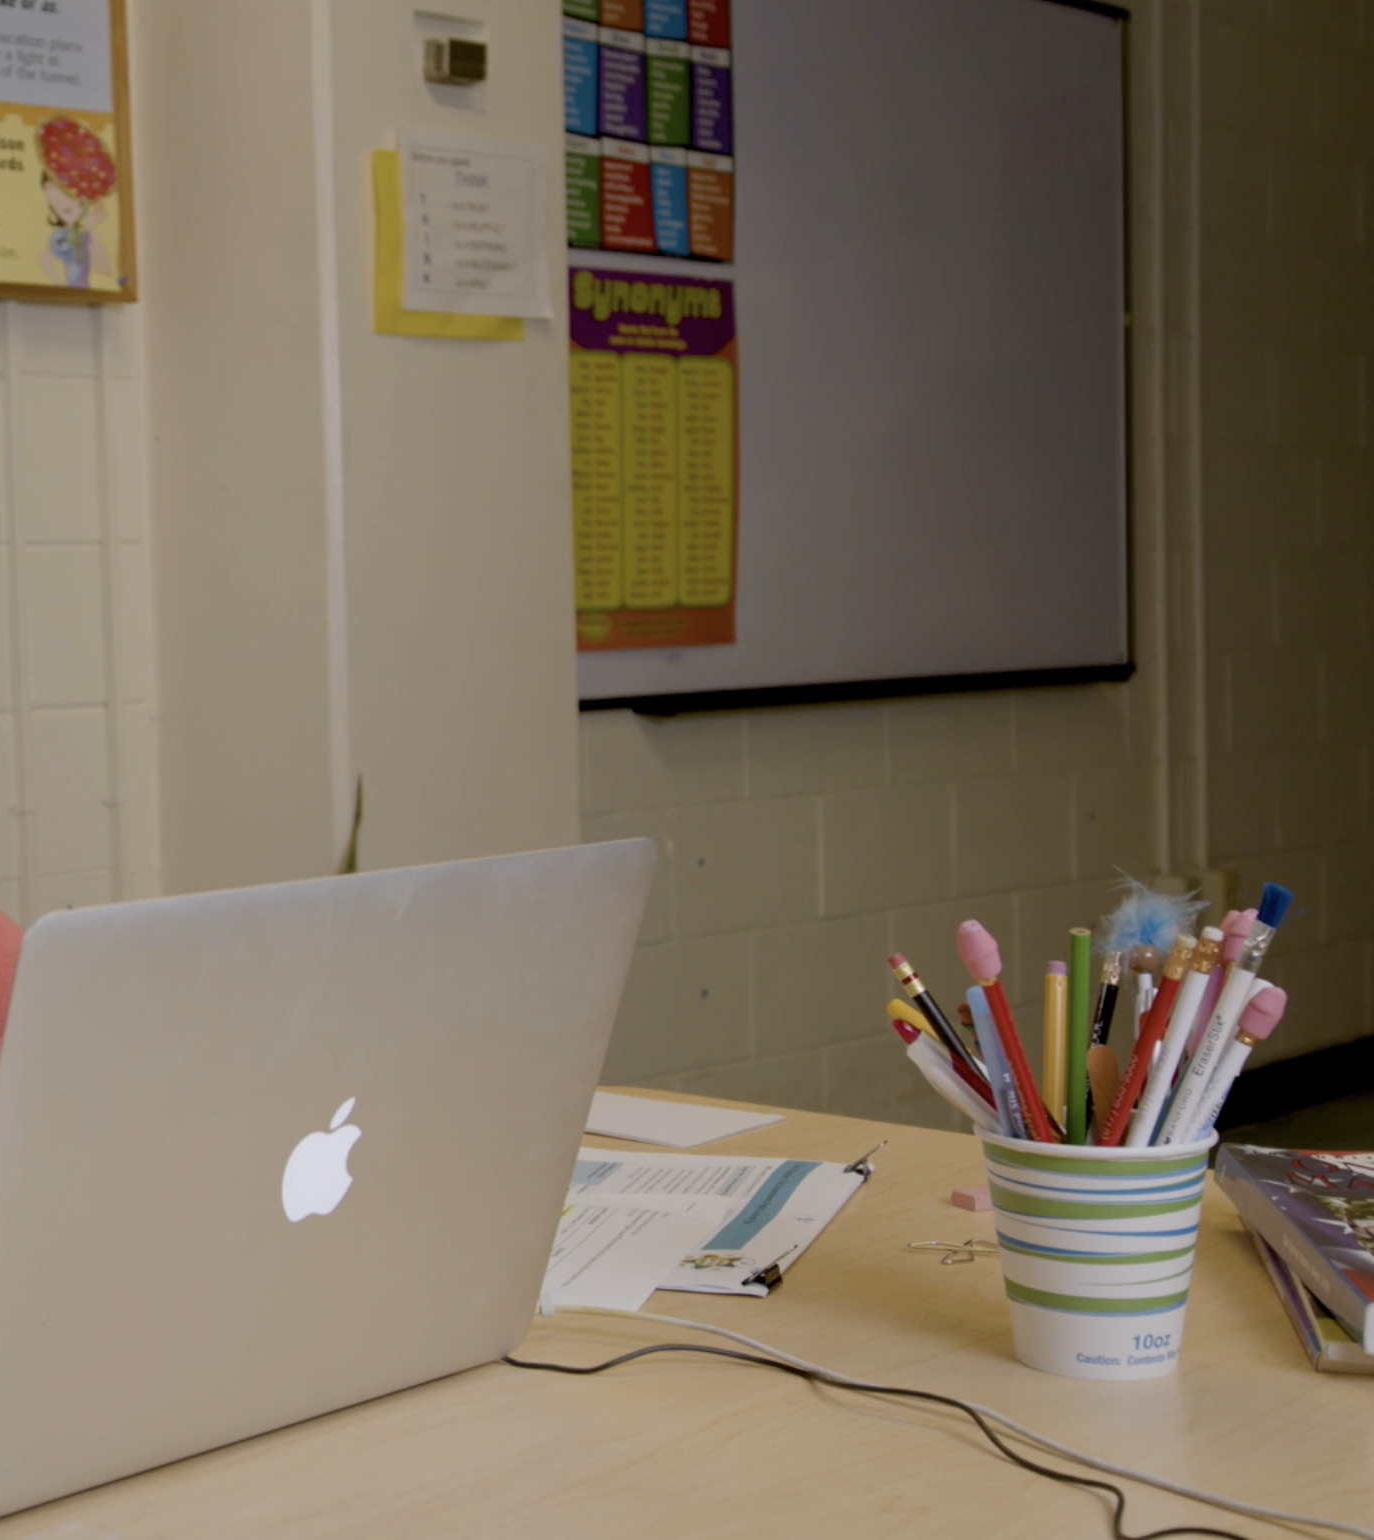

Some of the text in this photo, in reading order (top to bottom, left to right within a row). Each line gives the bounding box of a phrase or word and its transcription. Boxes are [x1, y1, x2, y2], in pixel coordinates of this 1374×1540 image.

[49, 36, 83, 53] plans
[4, 50, 13, 61] a
[17, 49, 44, 66] light
[47, 54, 60, 66] at
[0, 64, 13, 78] of
[16, 66, 36, 81] the
[573, 270, 722, 325] Synonyms
[1132, 1333, 1171, 1350] 10oz
[1076, 1352, 1122, 1366] Caution:
[1127, 1354, 1165, 1366] Contents
